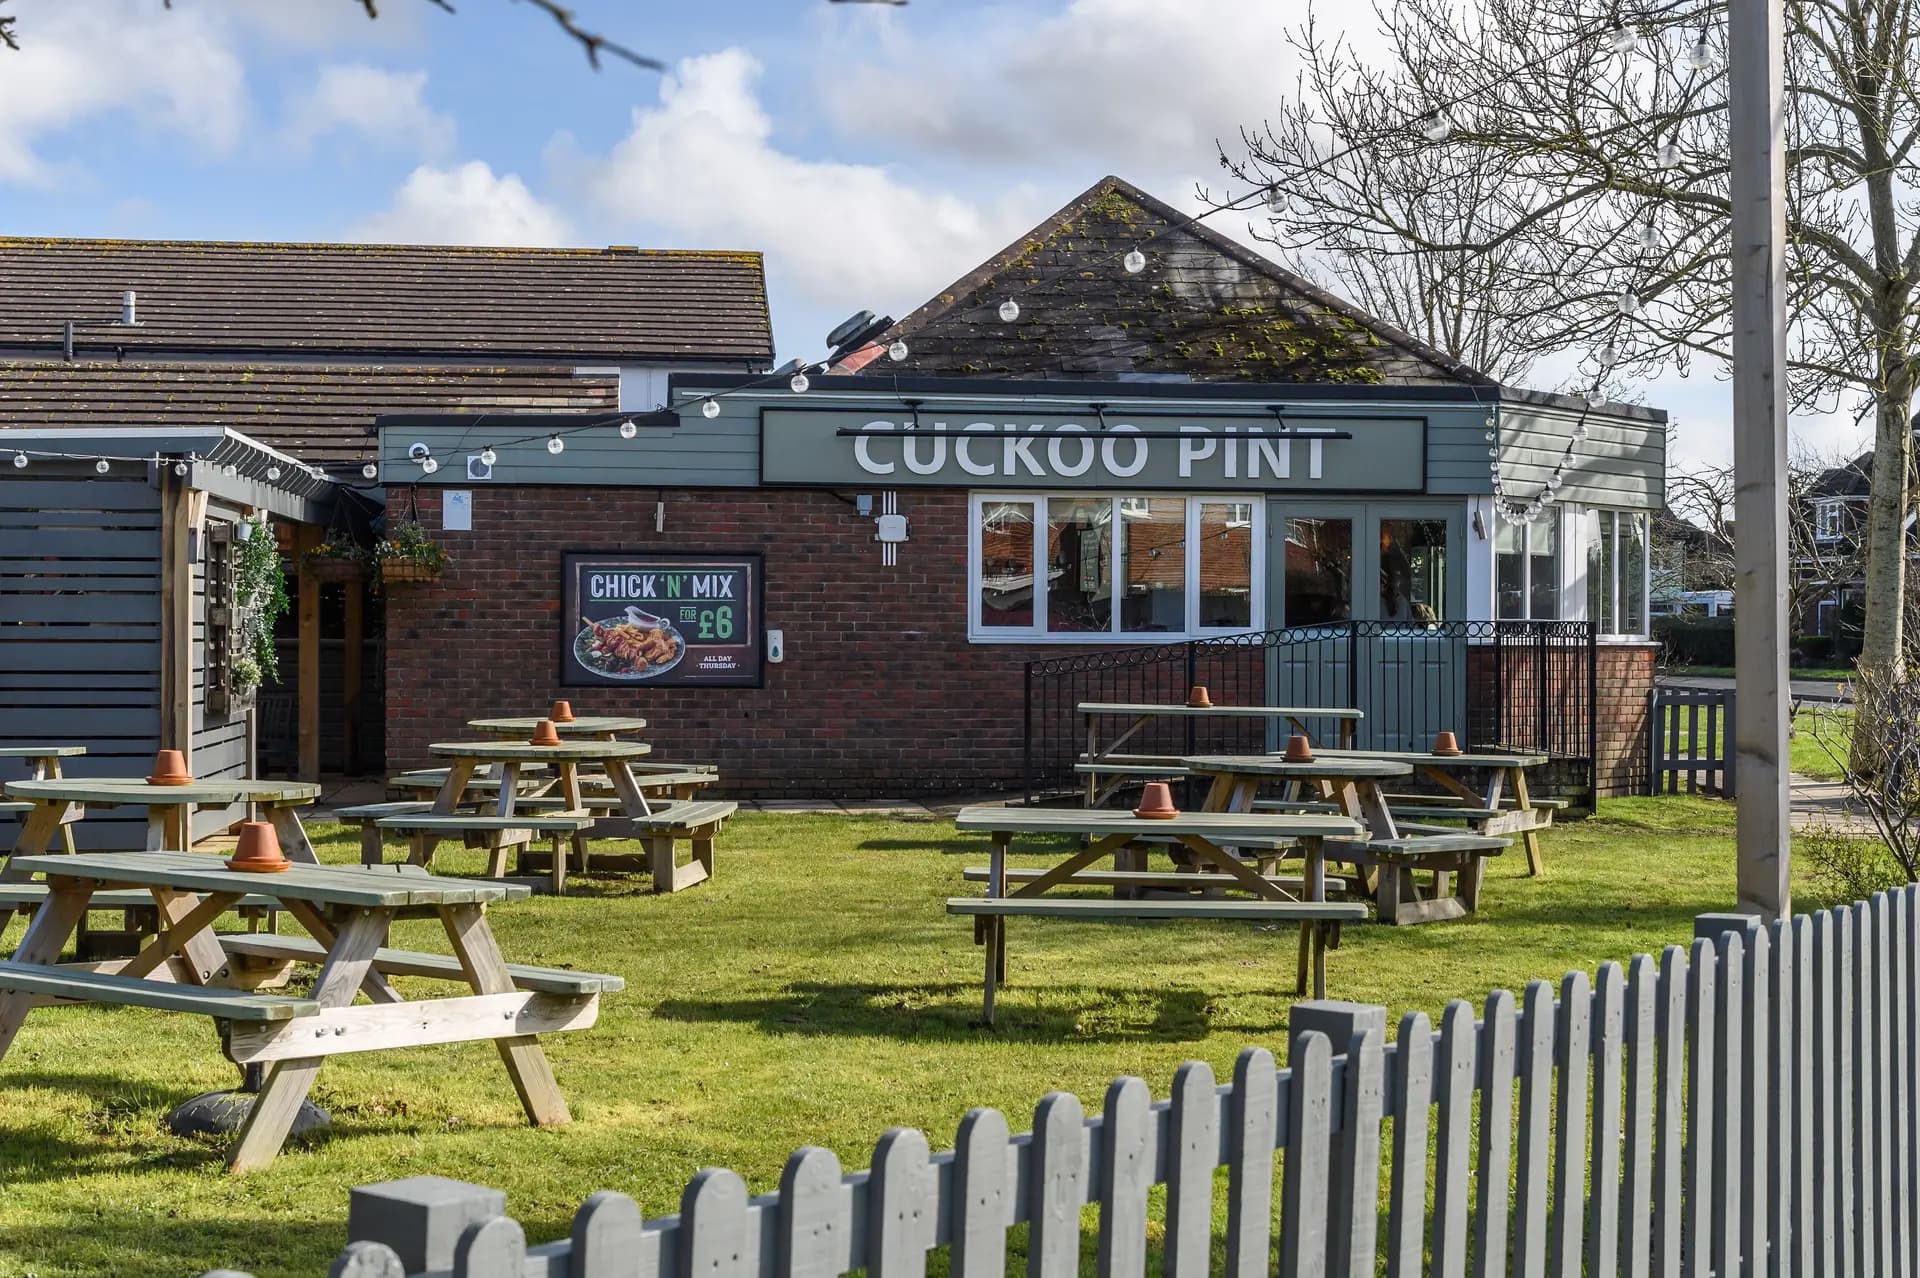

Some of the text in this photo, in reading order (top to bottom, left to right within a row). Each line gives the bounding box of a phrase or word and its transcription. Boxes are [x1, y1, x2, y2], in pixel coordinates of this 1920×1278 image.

[854, 421, 1336, 479] CUCKOO PINT
[590, 574, 657, 598] CHICK
[692, 574, 733, 598] MIX
[679, 605, 733, 639] FOR £6
[699, 662, 736, 670] THURSDAY
